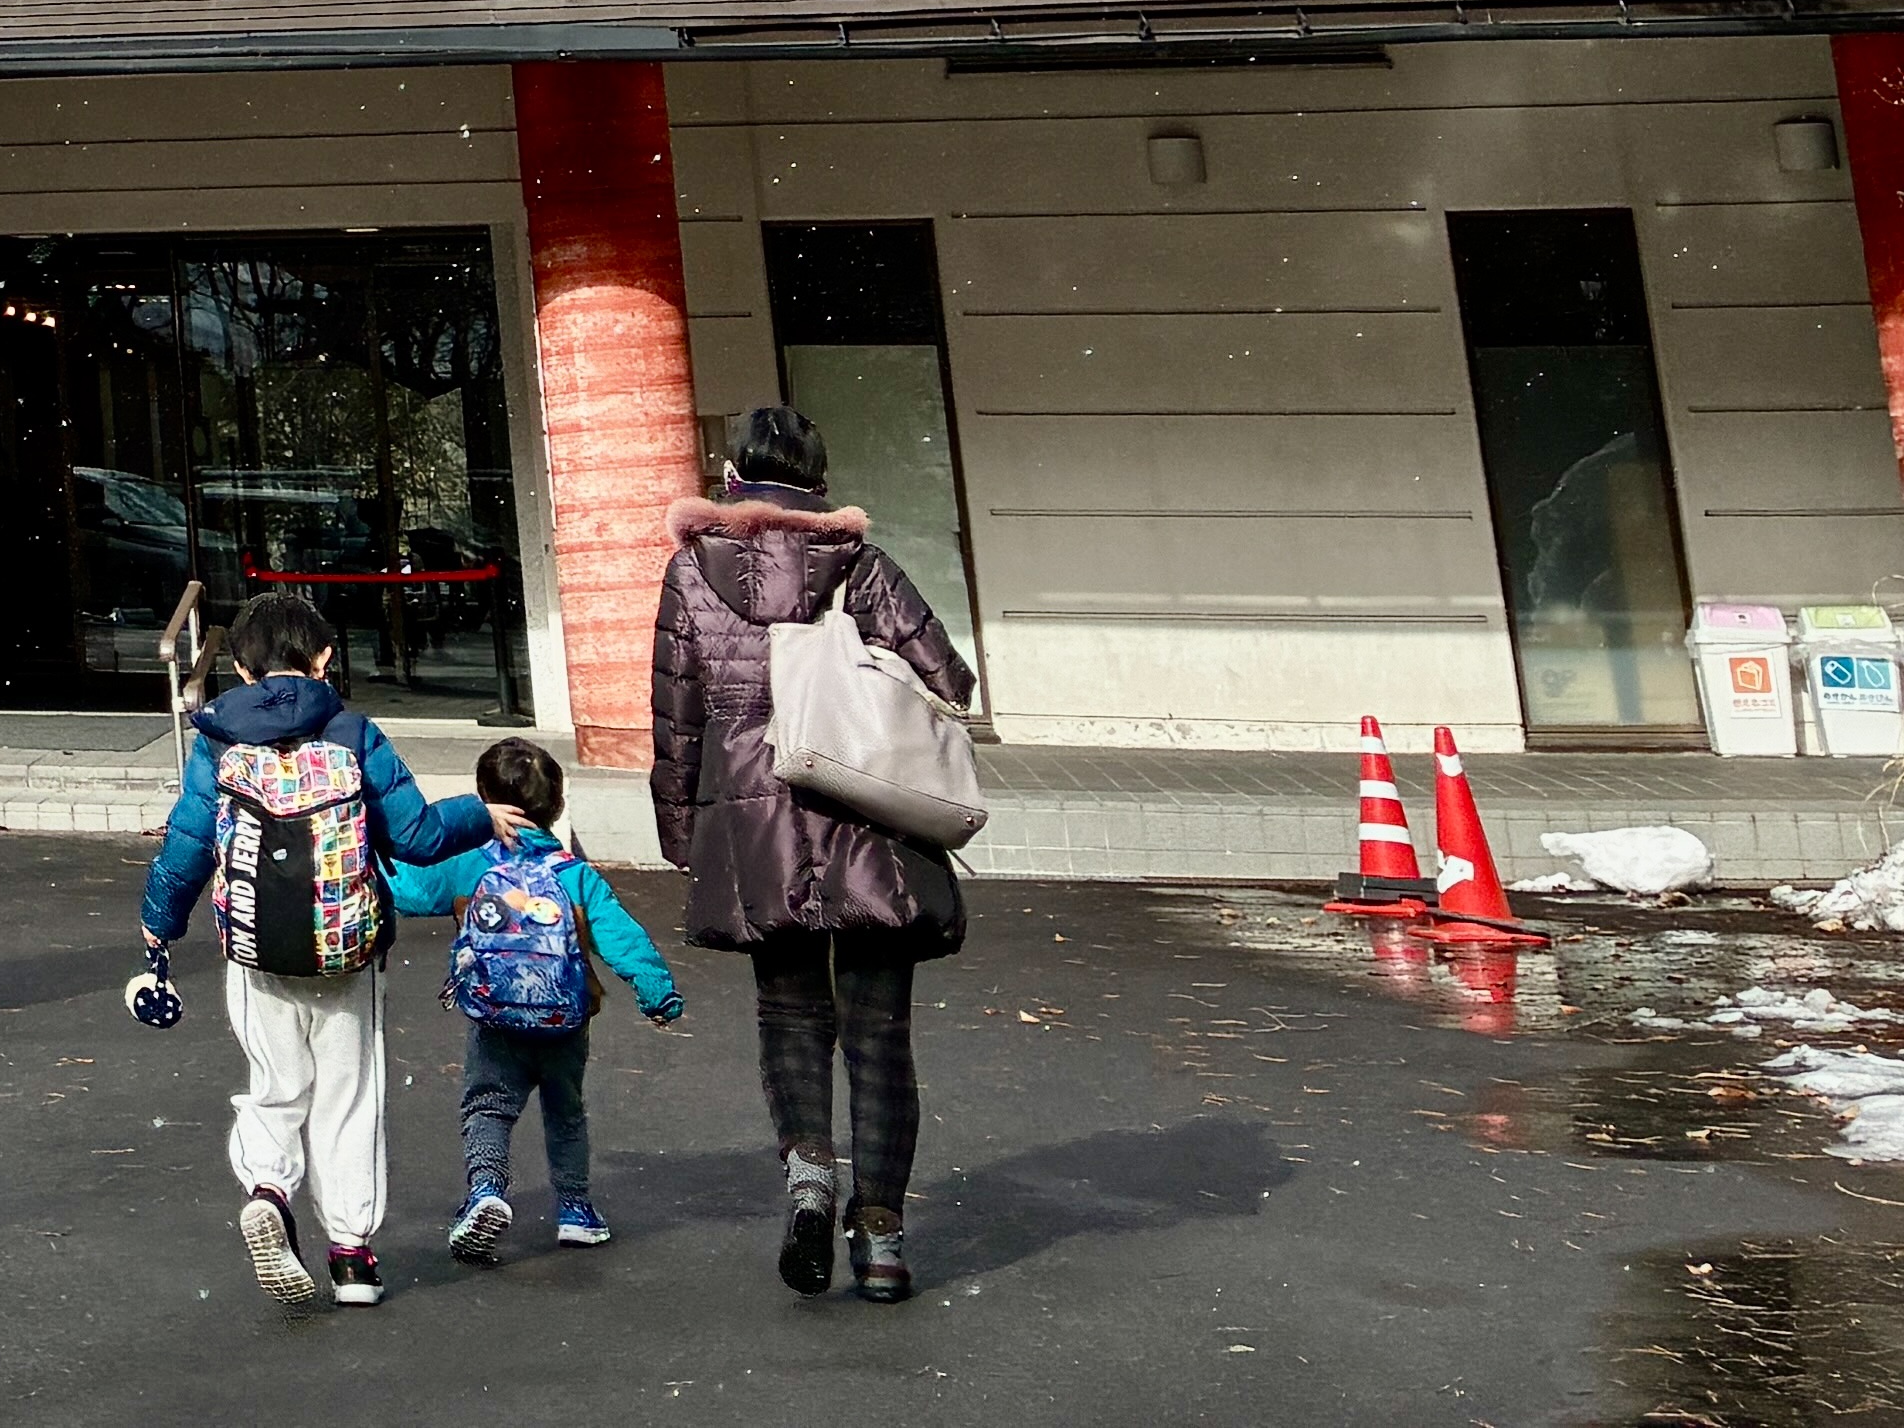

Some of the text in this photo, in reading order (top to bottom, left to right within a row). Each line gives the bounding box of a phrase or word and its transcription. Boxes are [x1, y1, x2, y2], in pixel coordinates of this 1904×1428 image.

[230, 808, 263, 967] TOM AND JERRY
